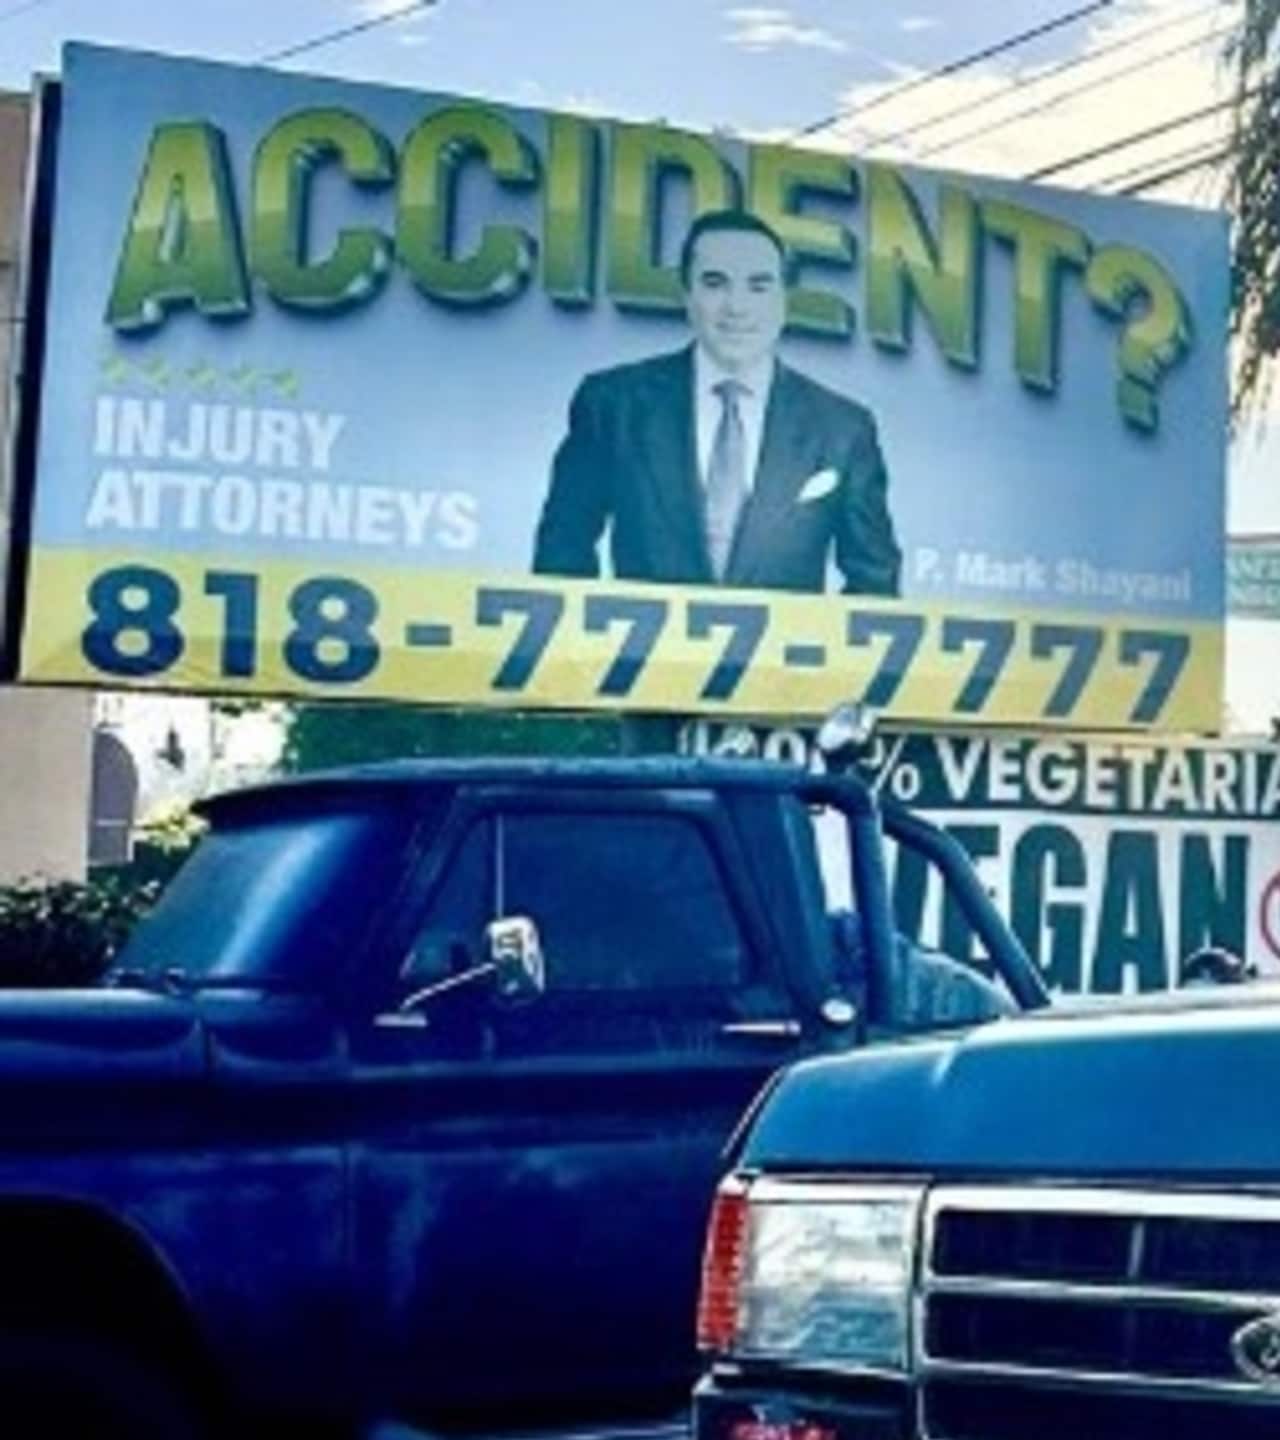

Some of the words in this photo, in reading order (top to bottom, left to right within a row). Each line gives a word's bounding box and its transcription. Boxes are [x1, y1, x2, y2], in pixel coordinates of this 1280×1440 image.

[104, 104, 1193, 437] ACCIDENT?
[94, 397, 346, 470] INJURY
[86, 471, 480, 550] ATTORNEYS
[956, 551, 1046, 592] Mark
[80, 563, 1193, 724] 818-777-7777
